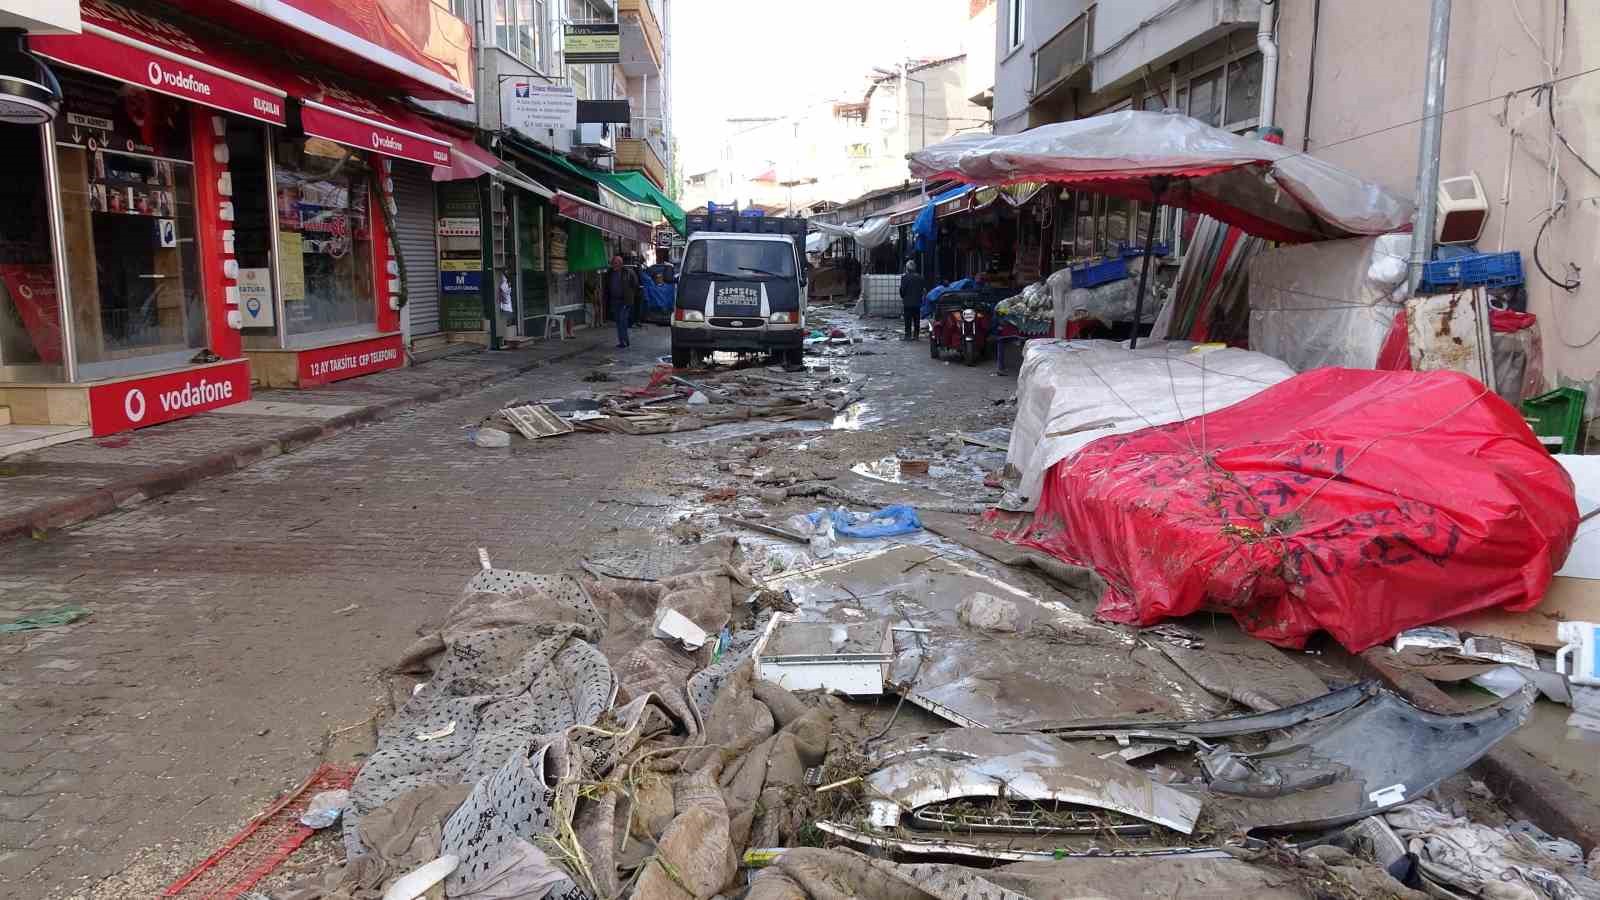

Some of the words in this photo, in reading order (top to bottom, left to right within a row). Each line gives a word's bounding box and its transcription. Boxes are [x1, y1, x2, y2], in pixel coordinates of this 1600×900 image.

[163, 70, 211, 95] vodafone
[310, 362, 320, 377] 12
[320, 360, 329, 374] AY
[359, 355, 370, 366] CEP
[160, 379, 233, 412] vodafone
